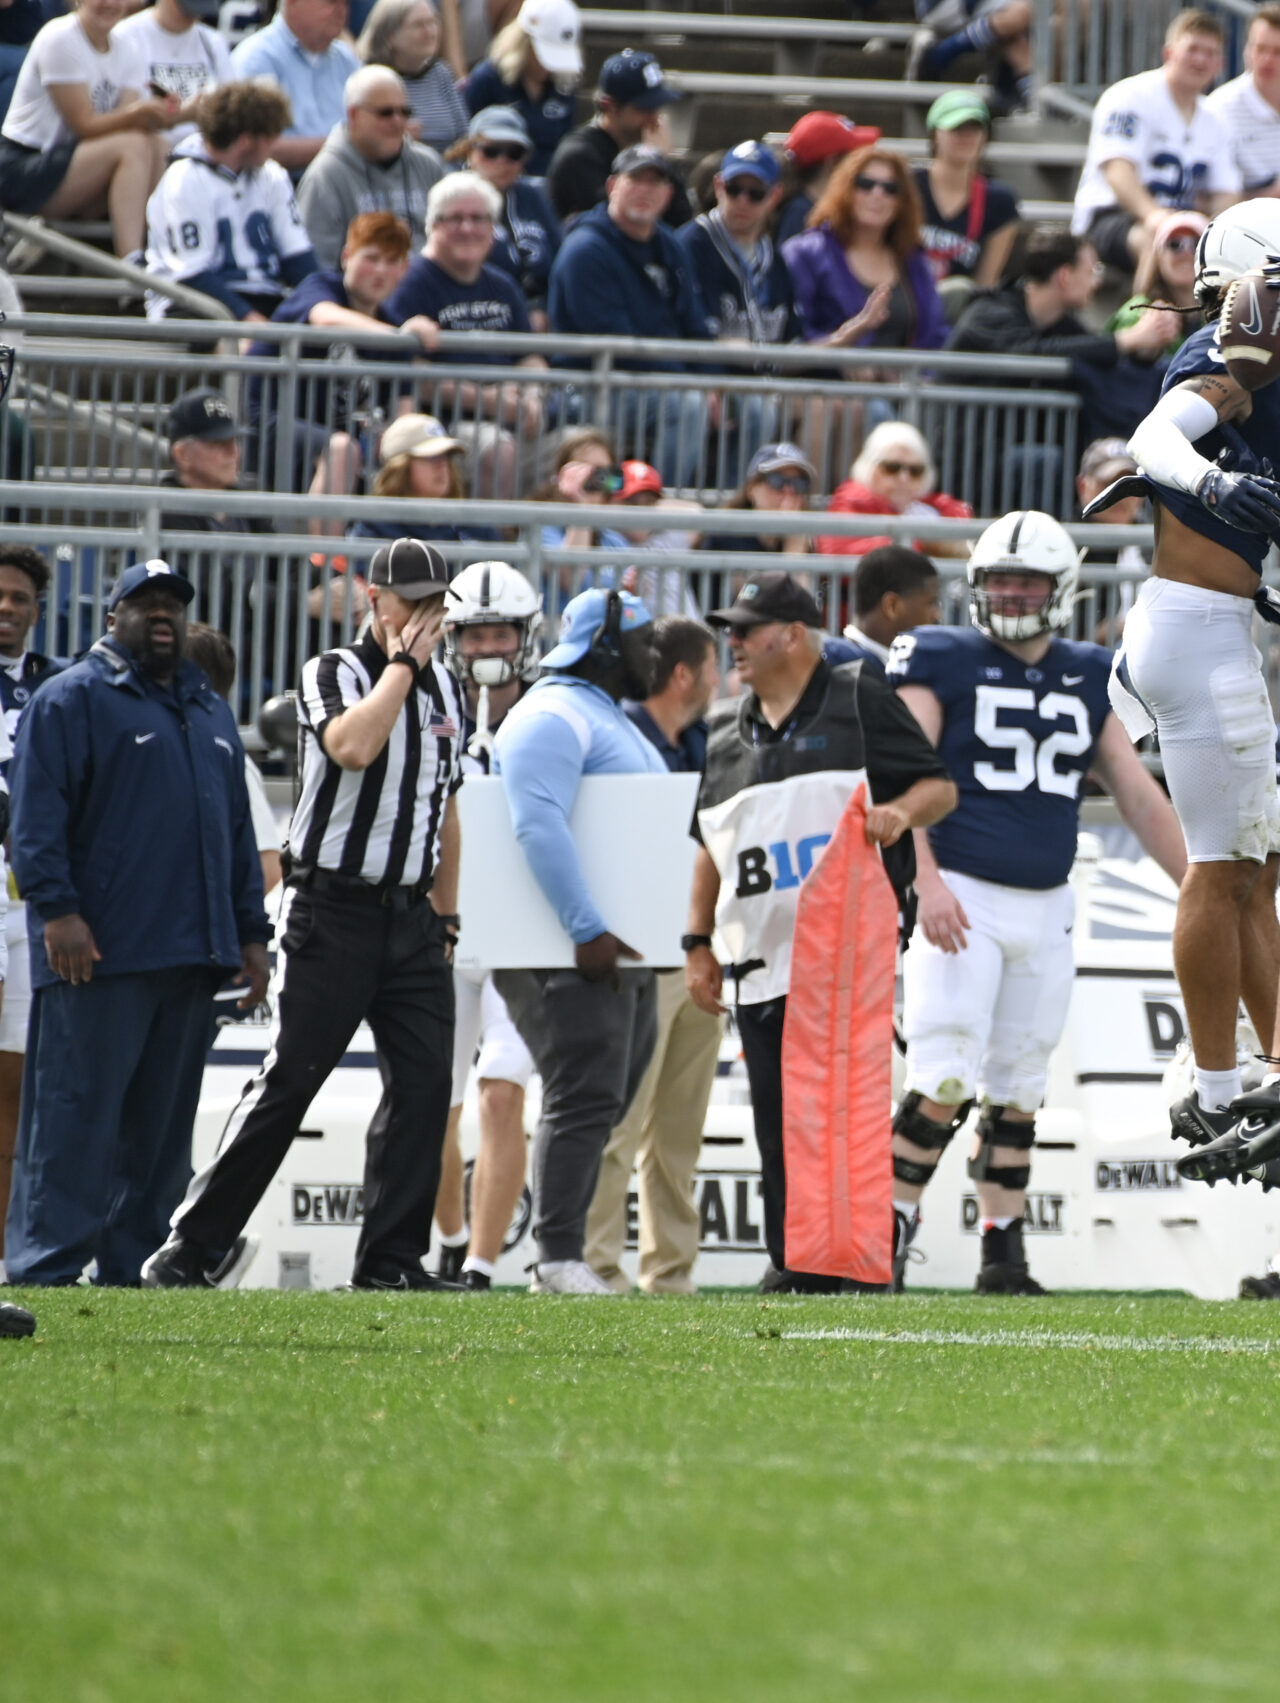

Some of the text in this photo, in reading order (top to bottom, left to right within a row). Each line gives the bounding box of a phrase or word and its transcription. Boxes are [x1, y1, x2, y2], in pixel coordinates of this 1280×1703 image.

[167, 221, 200, 254] 18
[973, 685, 1092, 799] 52
[294, 1189, 365, 1221] DEWA
[963, 1198, 1063, 1227] DALT
